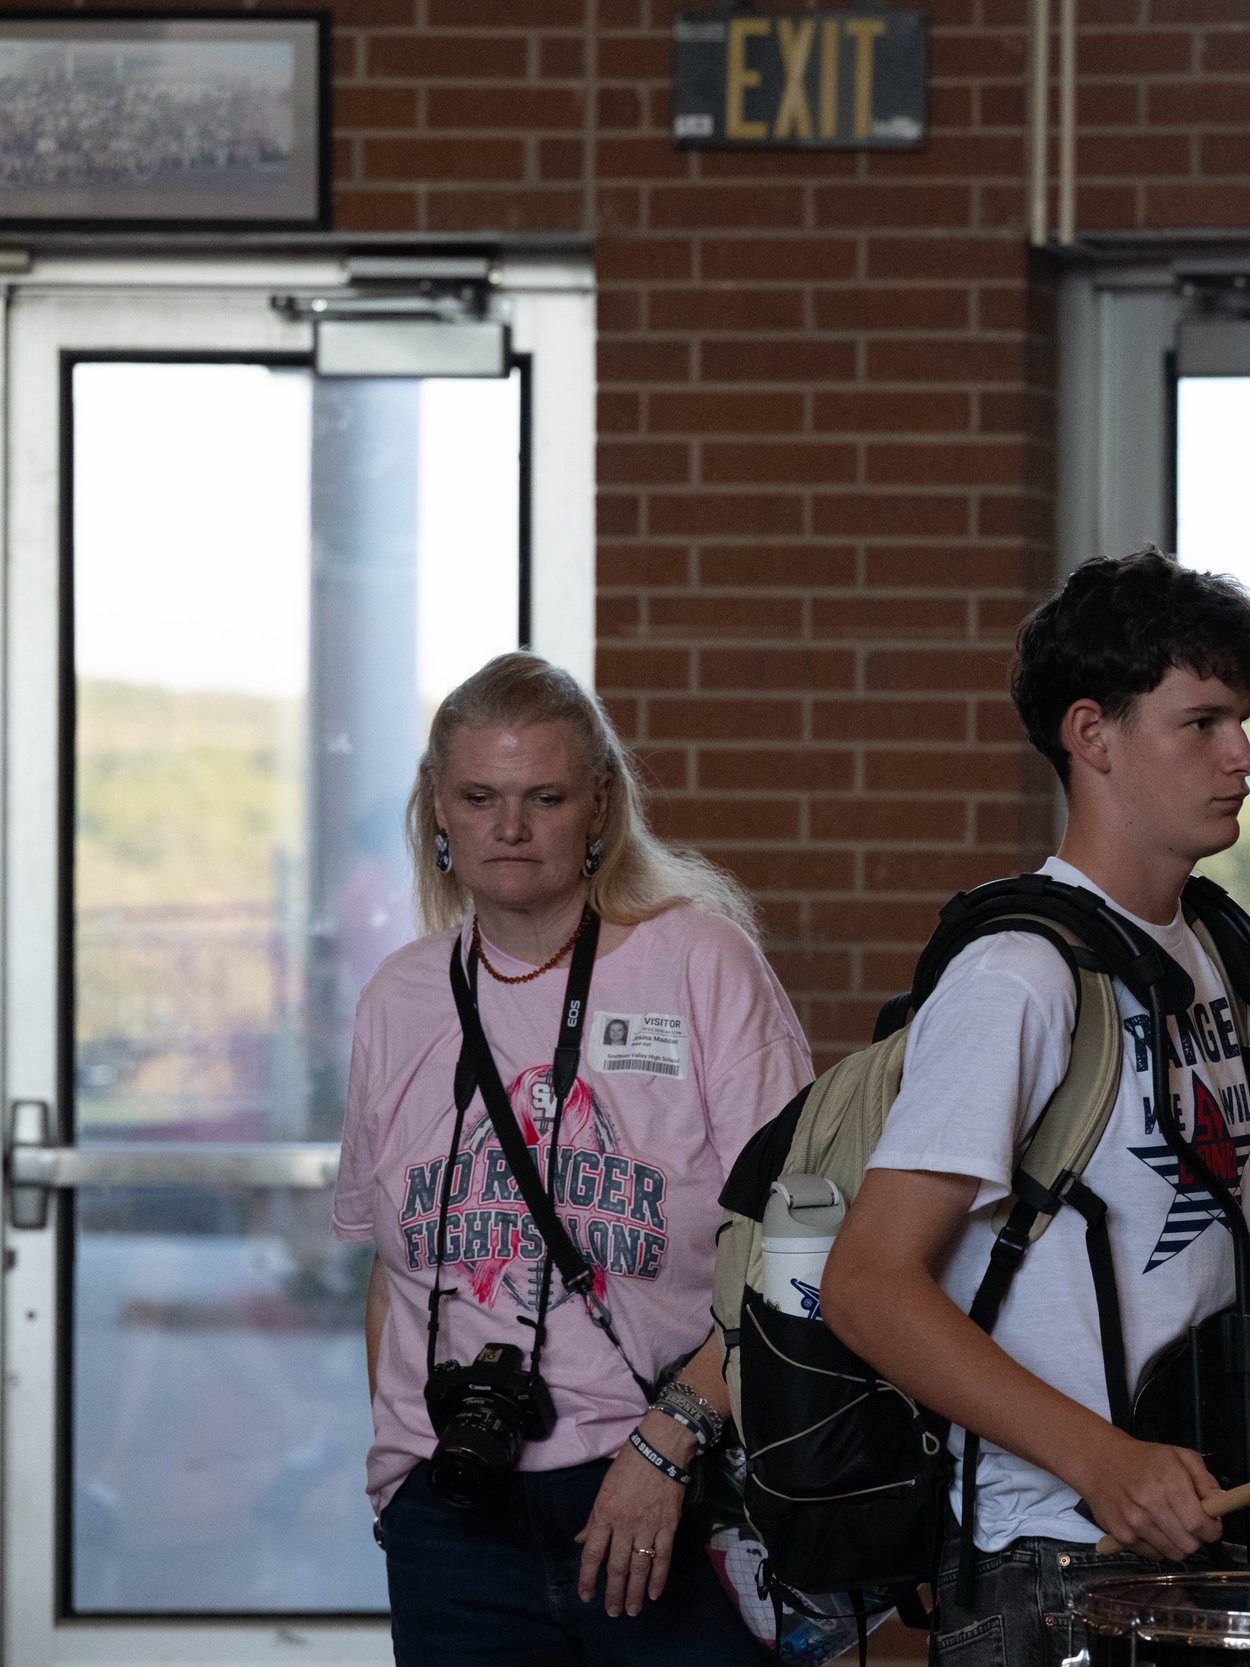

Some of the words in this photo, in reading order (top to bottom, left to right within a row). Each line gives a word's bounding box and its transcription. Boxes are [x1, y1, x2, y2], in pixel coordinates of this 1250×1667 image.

[725, 18, 886, 140] EXIT
[567, 1000, 581, 1028] EOS
[644, 1017, 681, 1028] VISITOR
[401, 1148, 475, 1222] NO
[556, 1217, 668, 1281] LONE
[638, 1442, 663, 1466] GUNS
